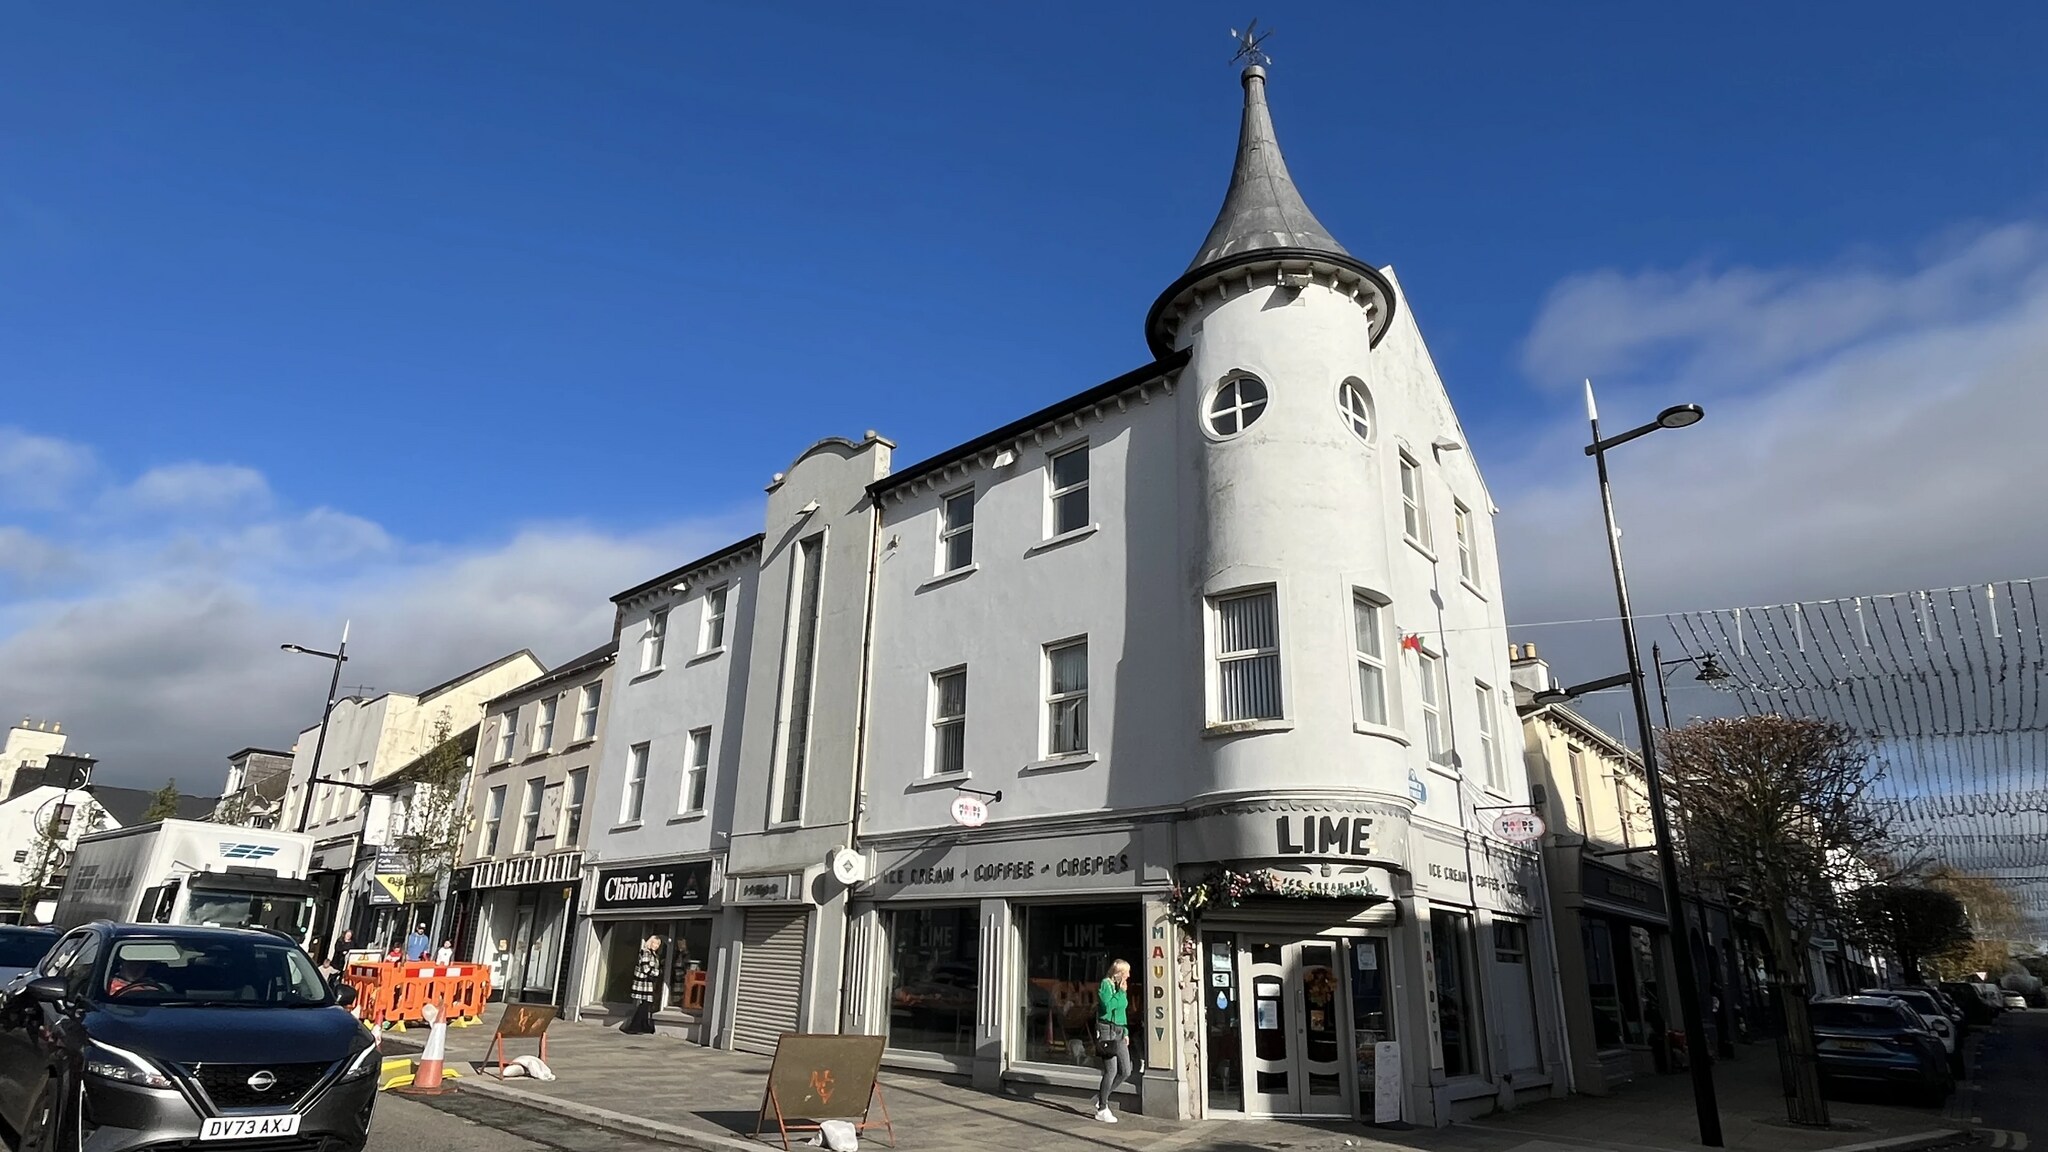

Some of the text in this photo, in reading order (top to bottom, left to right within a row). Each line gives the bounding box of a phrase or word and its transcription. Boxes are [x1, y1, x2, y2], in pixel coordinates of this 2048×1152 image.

[959, 803, 980, 812] MADS
[1276, 816, 1373, 856] LIME
[883, 854, 1128, 884] ICE CREAM COFFEE CREPES
[1429, 862, 1442, 879] ICE
[1444, 867, 1467, 883] CREAM
[605, 874, 673, 901] Chronicle
[920, 926, 953, 947] LIME
[1064, 924, 1105, 947] LIME
[1152, 926, 1165, 1020] MAUDS
[1424, 931, 1437, 1024] MAUDS
[209, 1117, 294, 1137] DV73 AXJ
